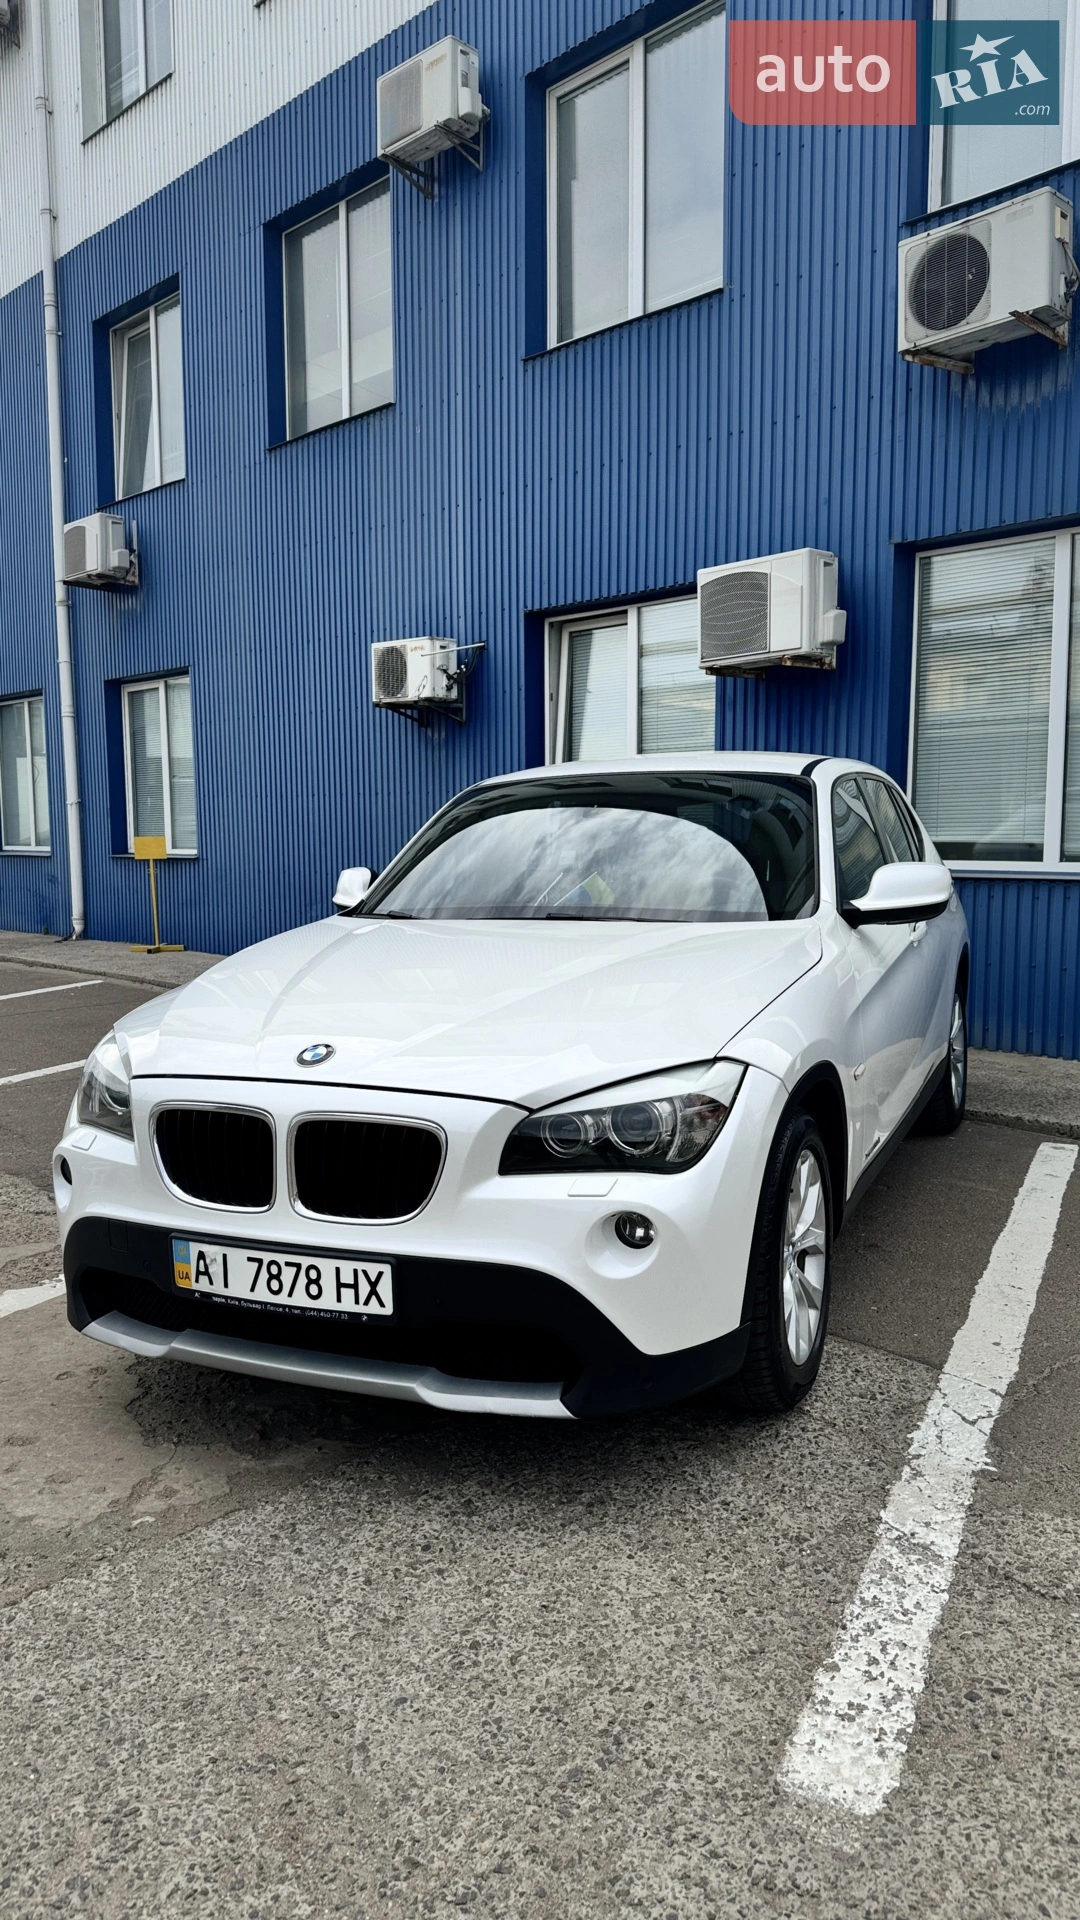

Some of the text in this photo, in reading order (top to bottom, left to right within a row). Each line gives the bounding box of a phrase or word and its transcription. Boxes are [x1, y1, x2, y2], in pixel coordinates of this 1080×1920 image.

[178, 1270, 191, 1282] UA
[194, 1249, 386, 1308] AI 7878 HX
